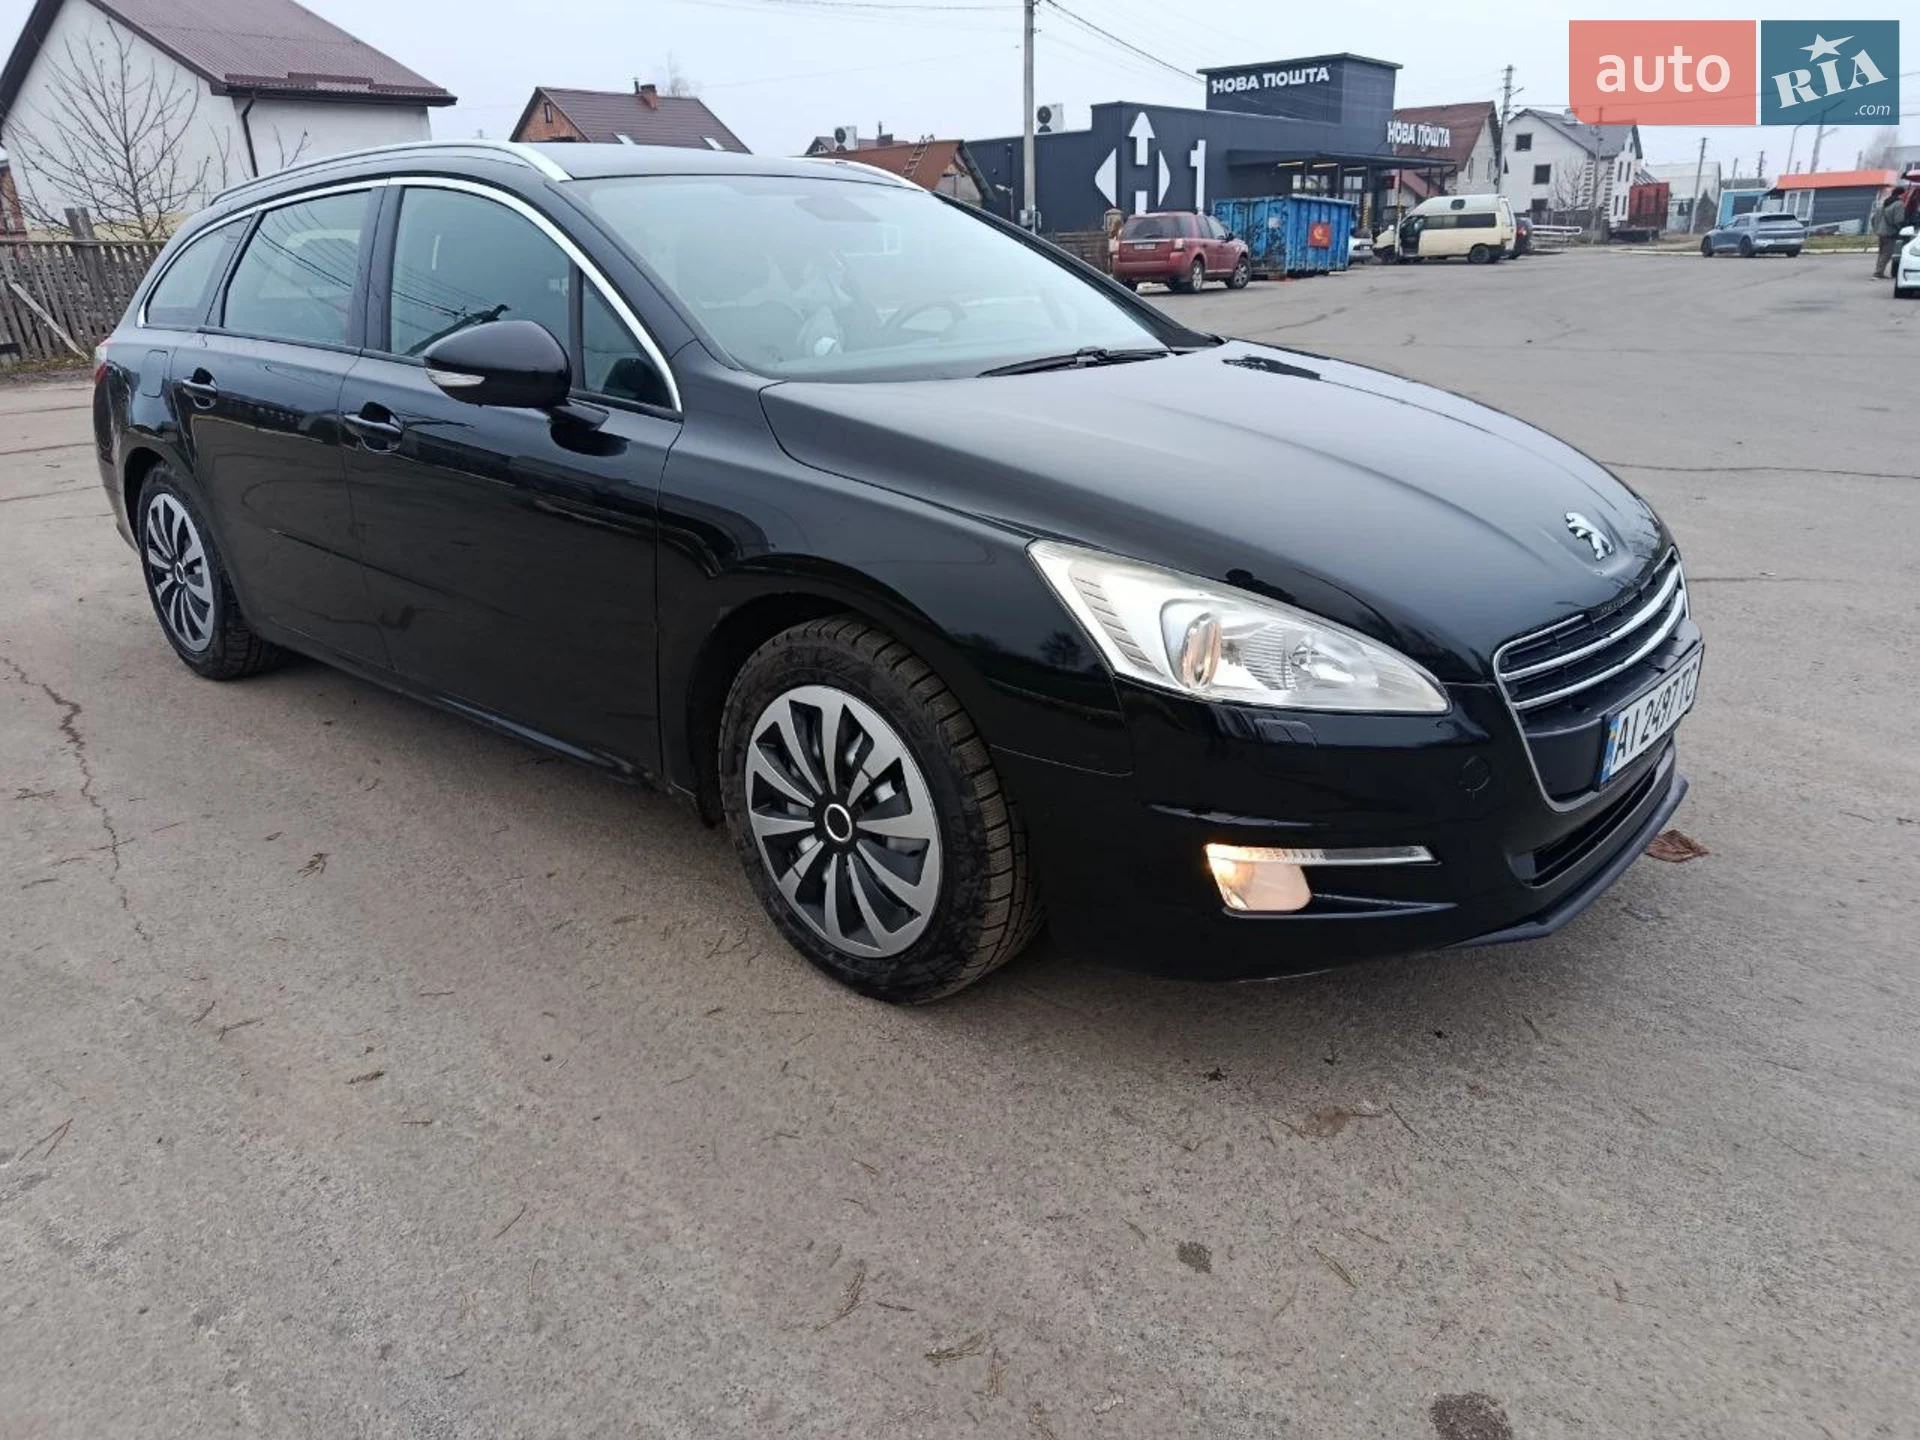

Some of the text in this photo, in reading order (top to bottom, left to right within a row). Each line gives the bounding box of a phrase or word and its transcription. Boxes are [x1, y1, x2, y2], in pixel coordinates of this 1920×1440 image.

[1212, 67, 1330, 94] НОВА ПОШТА
[1387, 121, 1450, 148] НОВА ПОШТА
[1190, 139, 1206, 215] 1
[1614, 707, 1640, 764] AI
[1639, 677, 1681, 744] 2497
